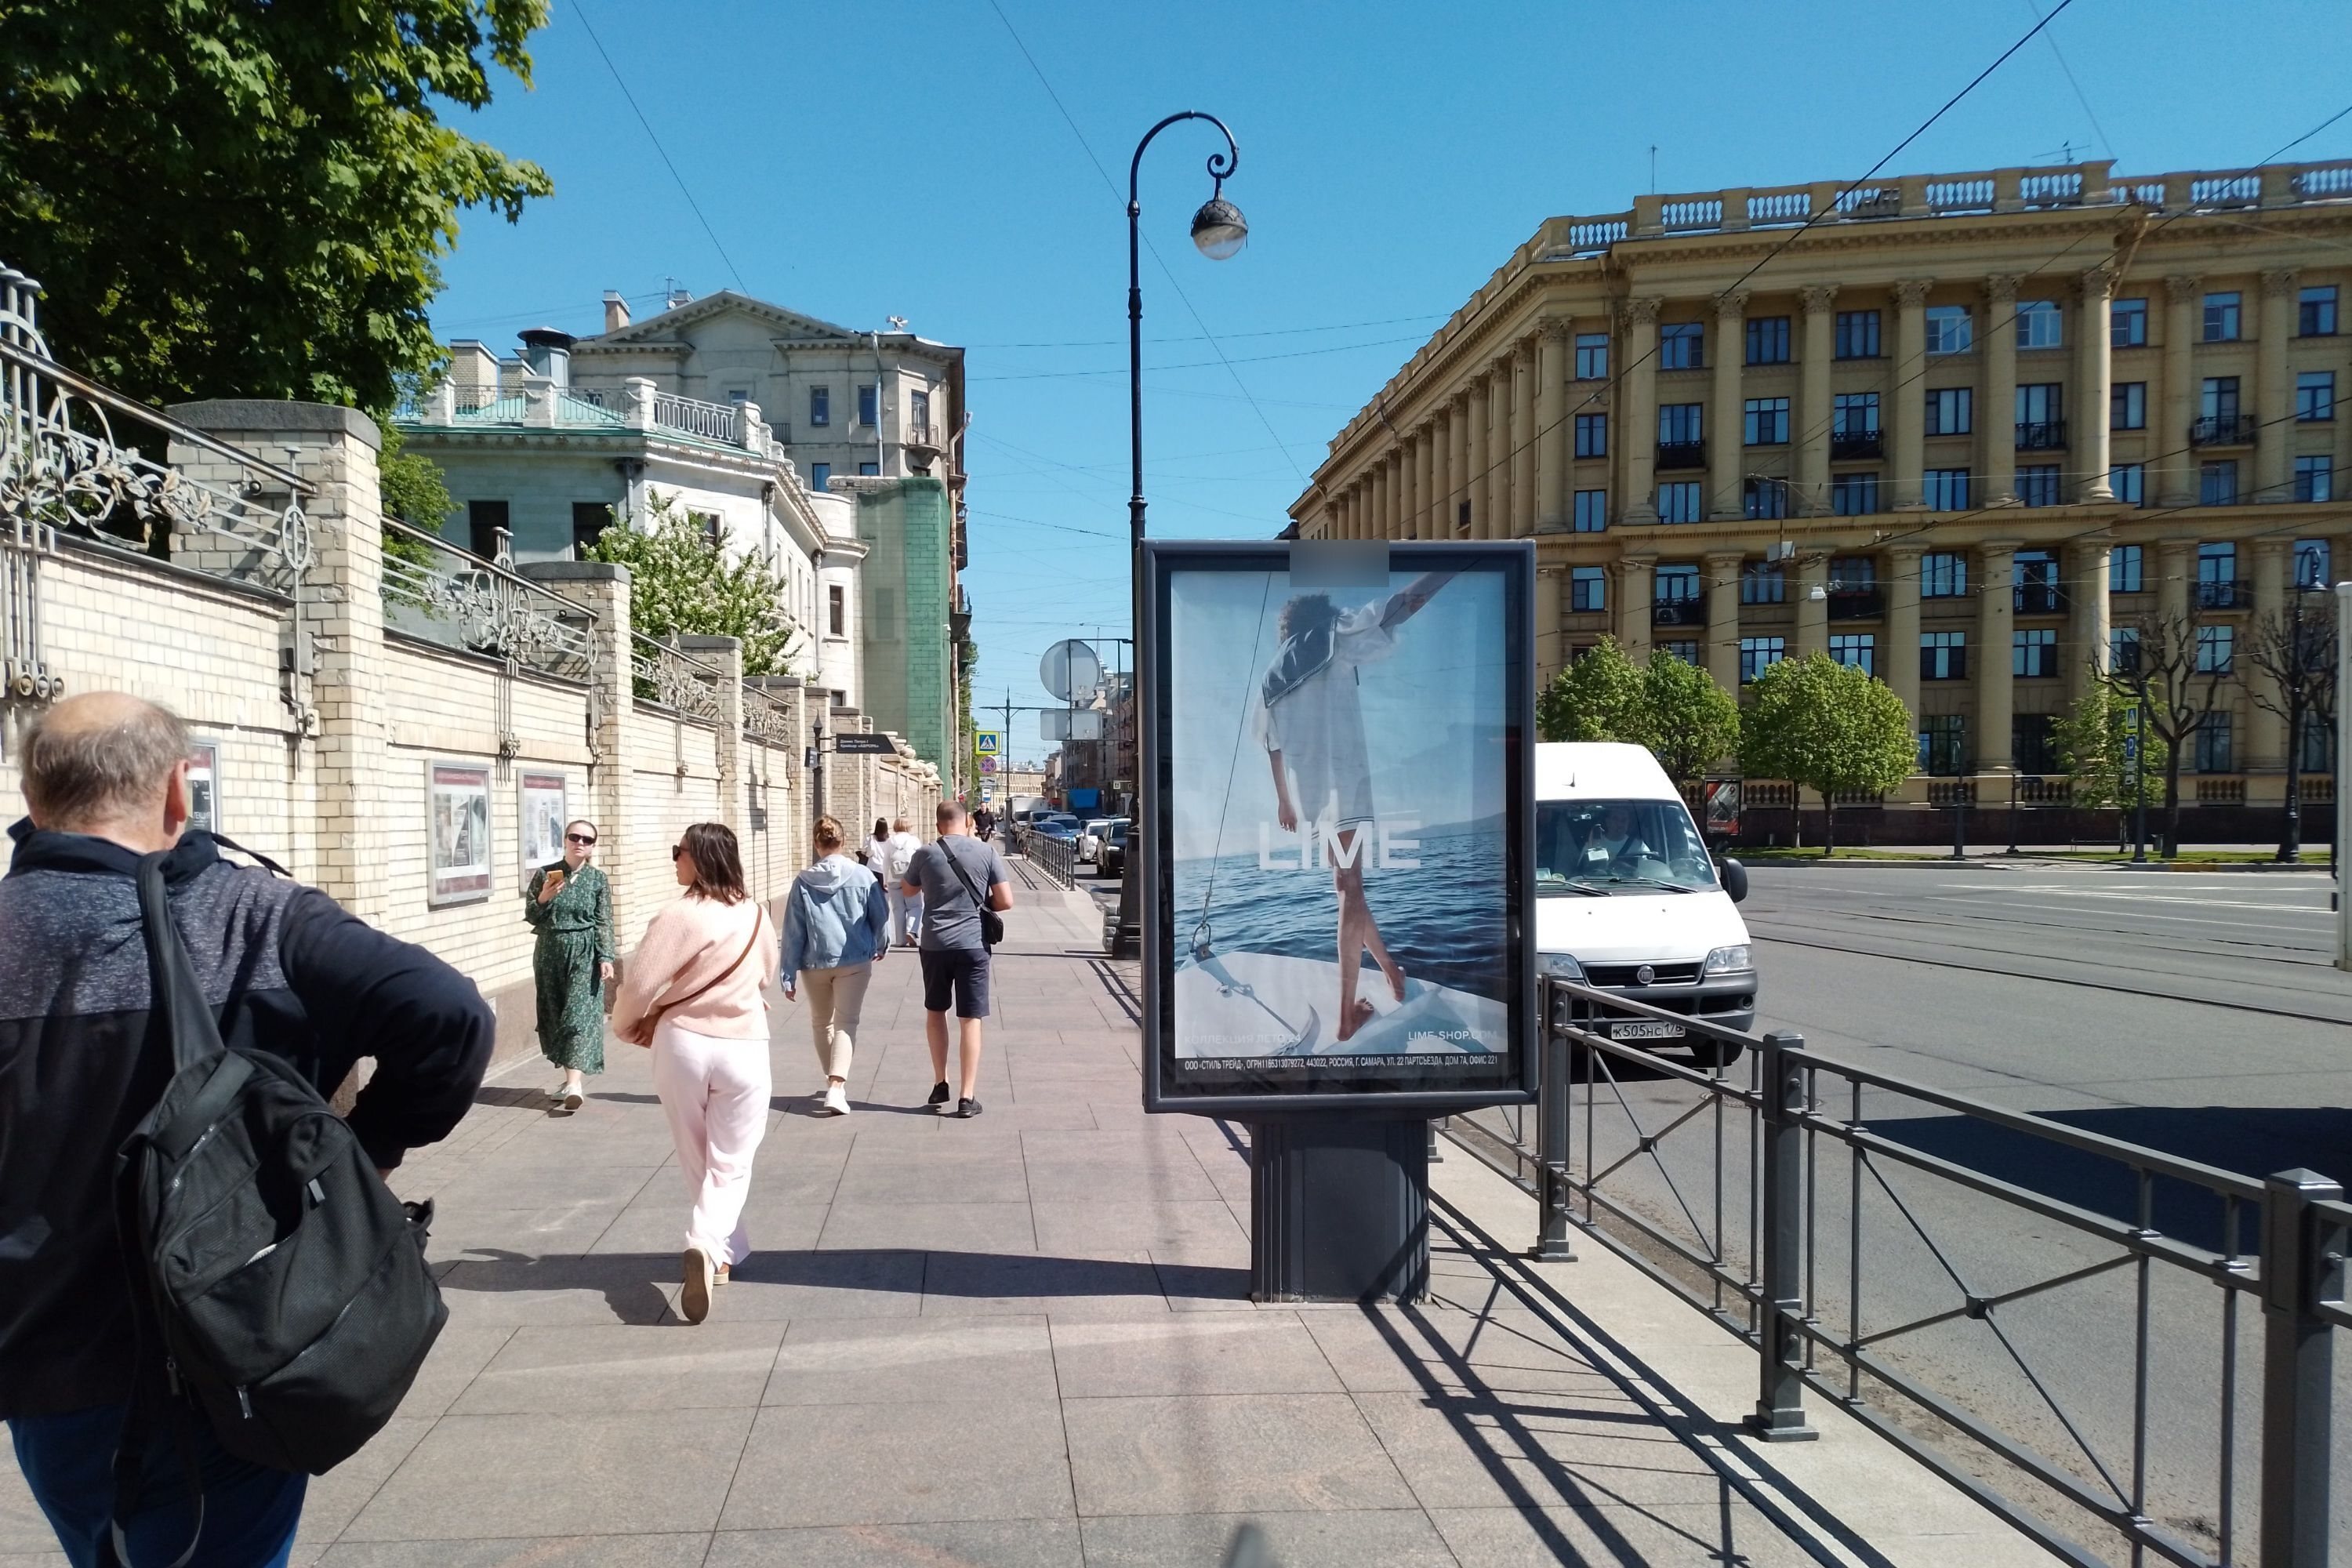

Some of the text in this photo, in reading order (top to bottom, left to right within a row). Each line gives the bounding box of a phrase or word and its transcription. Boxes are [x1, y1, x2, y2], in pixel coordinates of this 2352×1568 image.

[1259, 820, 1421, 869] LIME
[1185, 1034, 1254, 1046] КОЛЛЕКЦИЯ
[1255, 1034, 1286, 1044] ЛЕТО
[1408, 1030, 1497, 1041] LIME-SHOP.COM
[1185, 1060, 1198, 1070] ООО
[1199, 1059, 1221, 1070] «СТИЛЬ
[1306, 1058, 1328, 1069] 443022,
[1329, 1057, 1355, 1068] РОССИЯ,
[1356, 1057, 1360, 1067] Г.
[1360, 1056, 1386, 1067] САМАРА,
[1386, 1056, 1396, 1066] УЛ.
[1396, 1056, 1404, 1065] 22
[1444, 1055, 1459, 1066] ДОМ
[1460, 1055, 1468, 1065] 7А,
[1469, 1055, 1487, 1065] ОФИС
[1487, 1054, 1497, 1065] 221
